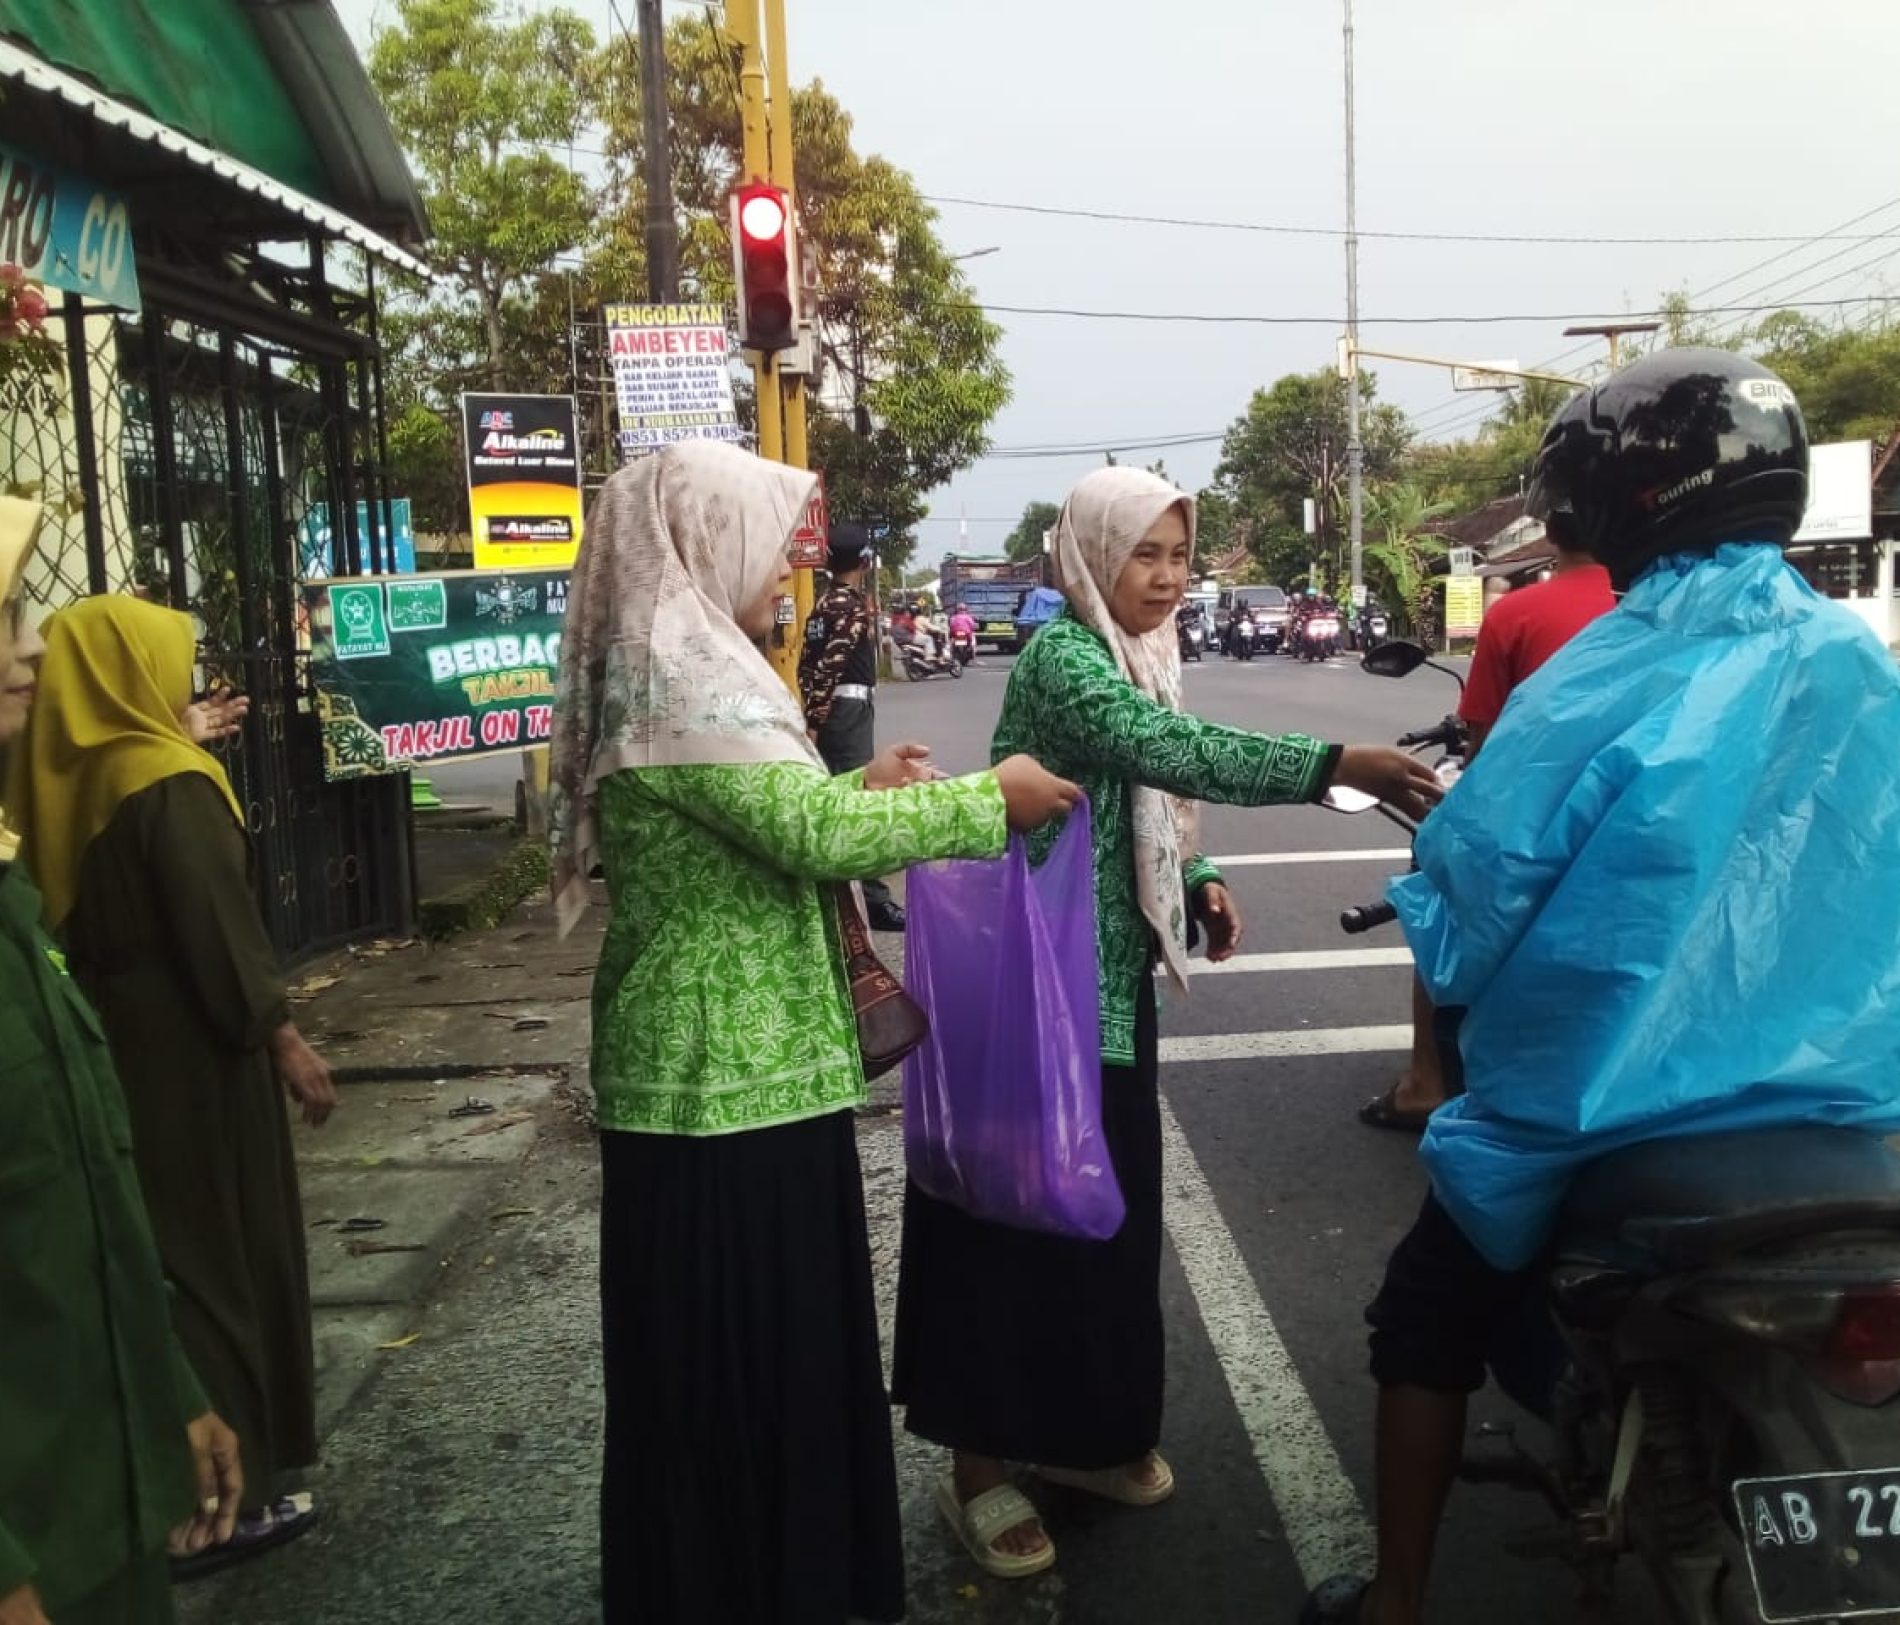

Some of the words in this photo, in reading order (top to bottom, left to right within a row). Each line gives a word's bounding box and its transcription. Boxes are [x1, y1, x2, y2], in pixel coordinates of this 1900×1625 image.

[605, 305, 723, 326] PENGOBATAN
[612, 330, 725, 354] AMBEYEN
[615, 357, 660, 369] TANPA
[665, 355, 727, 368] OPERASI
[482, 431, 565, 450] Alkaline
[622, 430, 657, 444] 0853
[382, 716, 474, 759] TAKJIL
[481, 710, 519, 744] ON
[1754, 1492, 1818, 1547] AB
